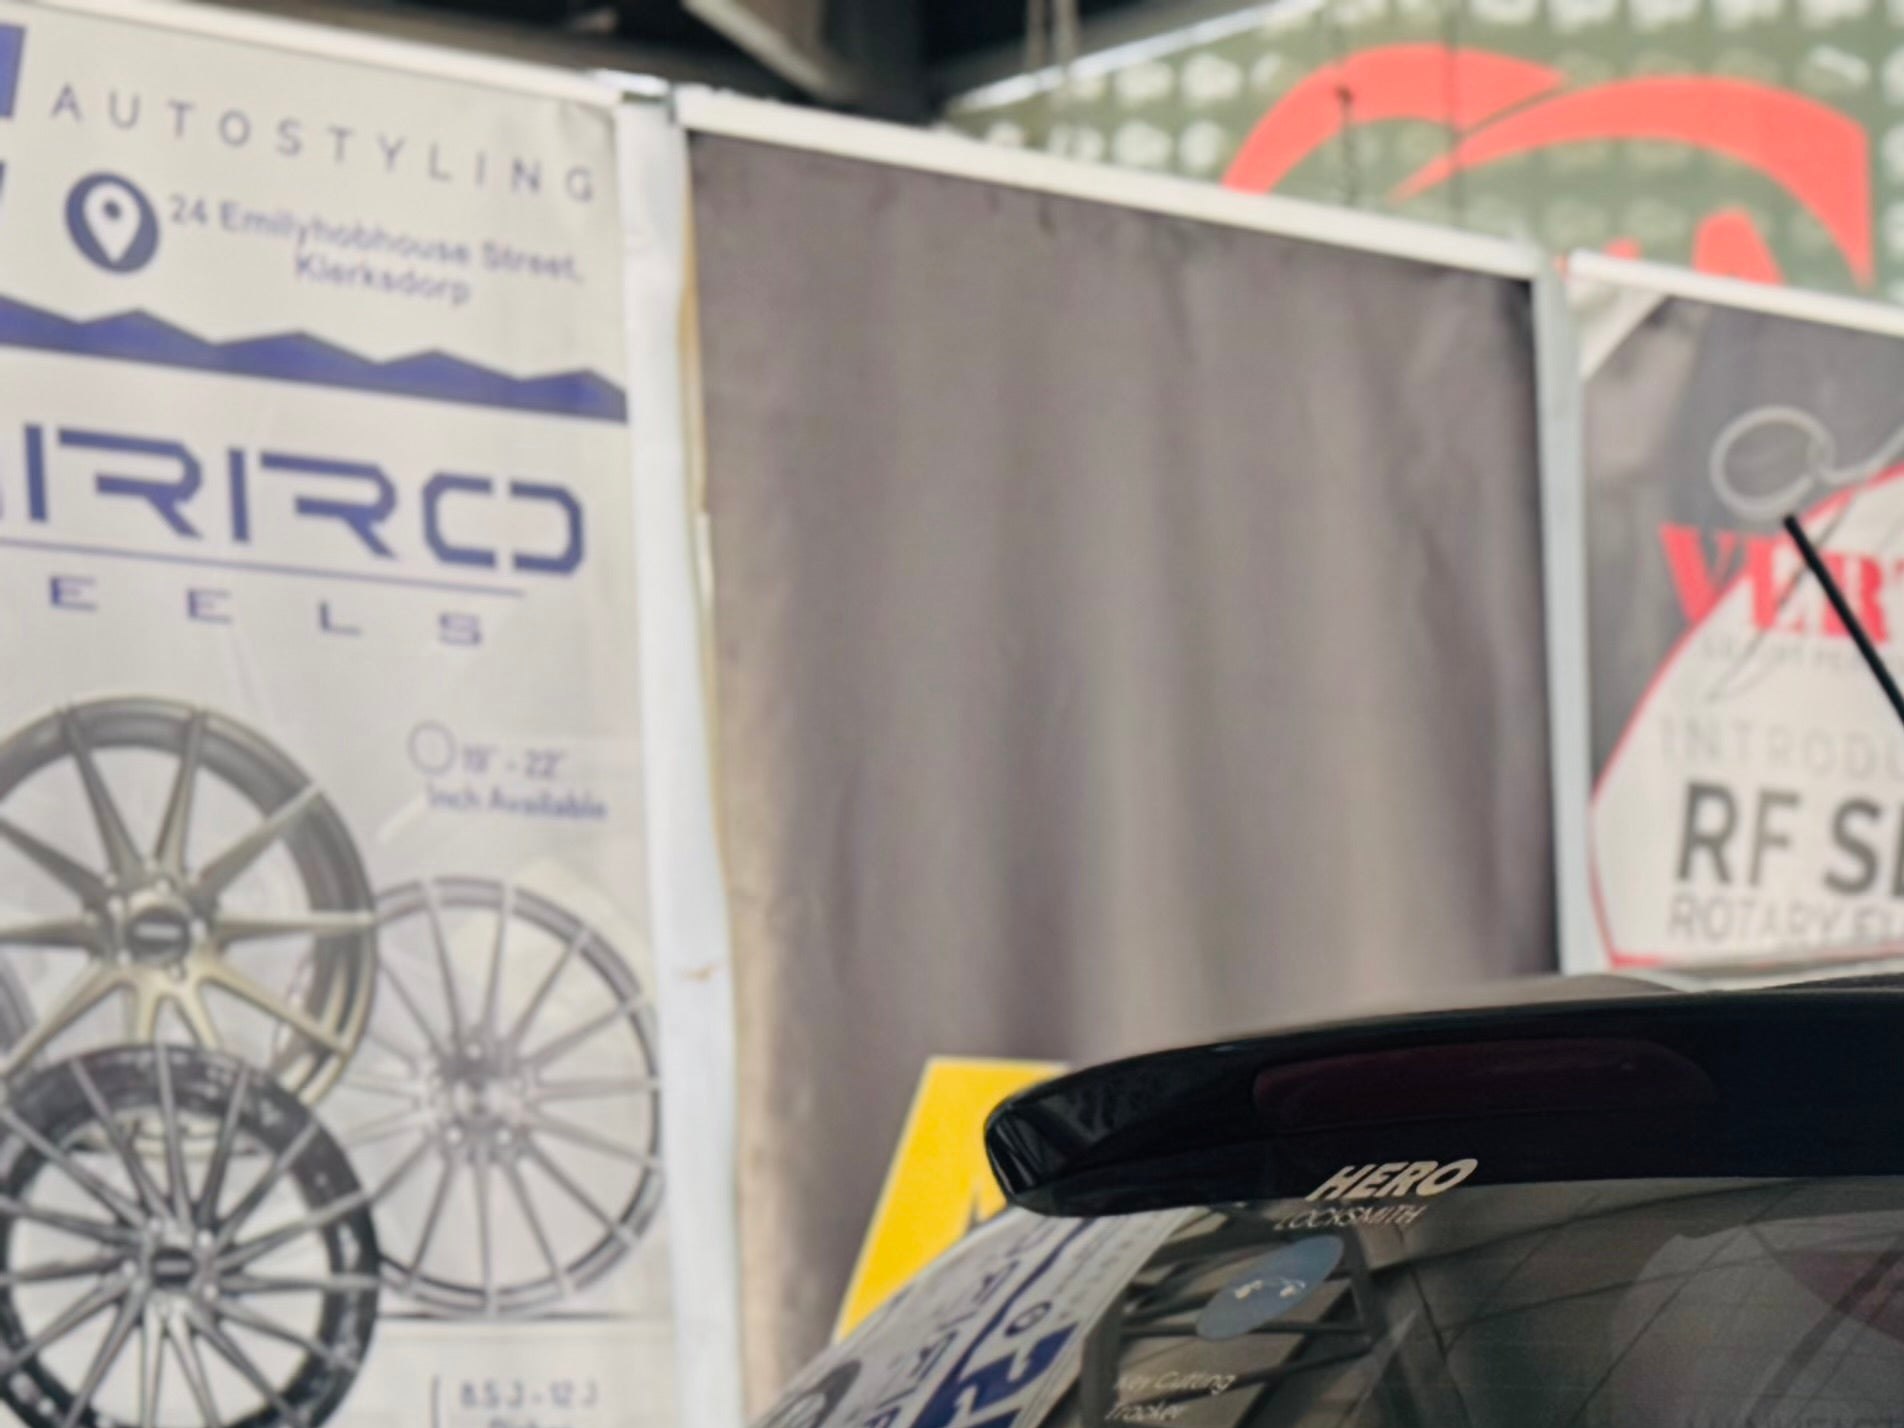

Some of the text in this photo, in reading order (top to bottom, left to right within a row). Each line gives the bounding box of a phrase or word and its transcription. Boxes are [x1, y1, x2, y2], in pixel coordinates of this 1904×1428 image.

[52, 83, 598, 202] AUTOSTYLING
[1675, 781, 1801, 888] RF
[1304, 1157, 1479, 1201] HERO
[1273, 1204, 1428, 1232] LOCKSMITH
